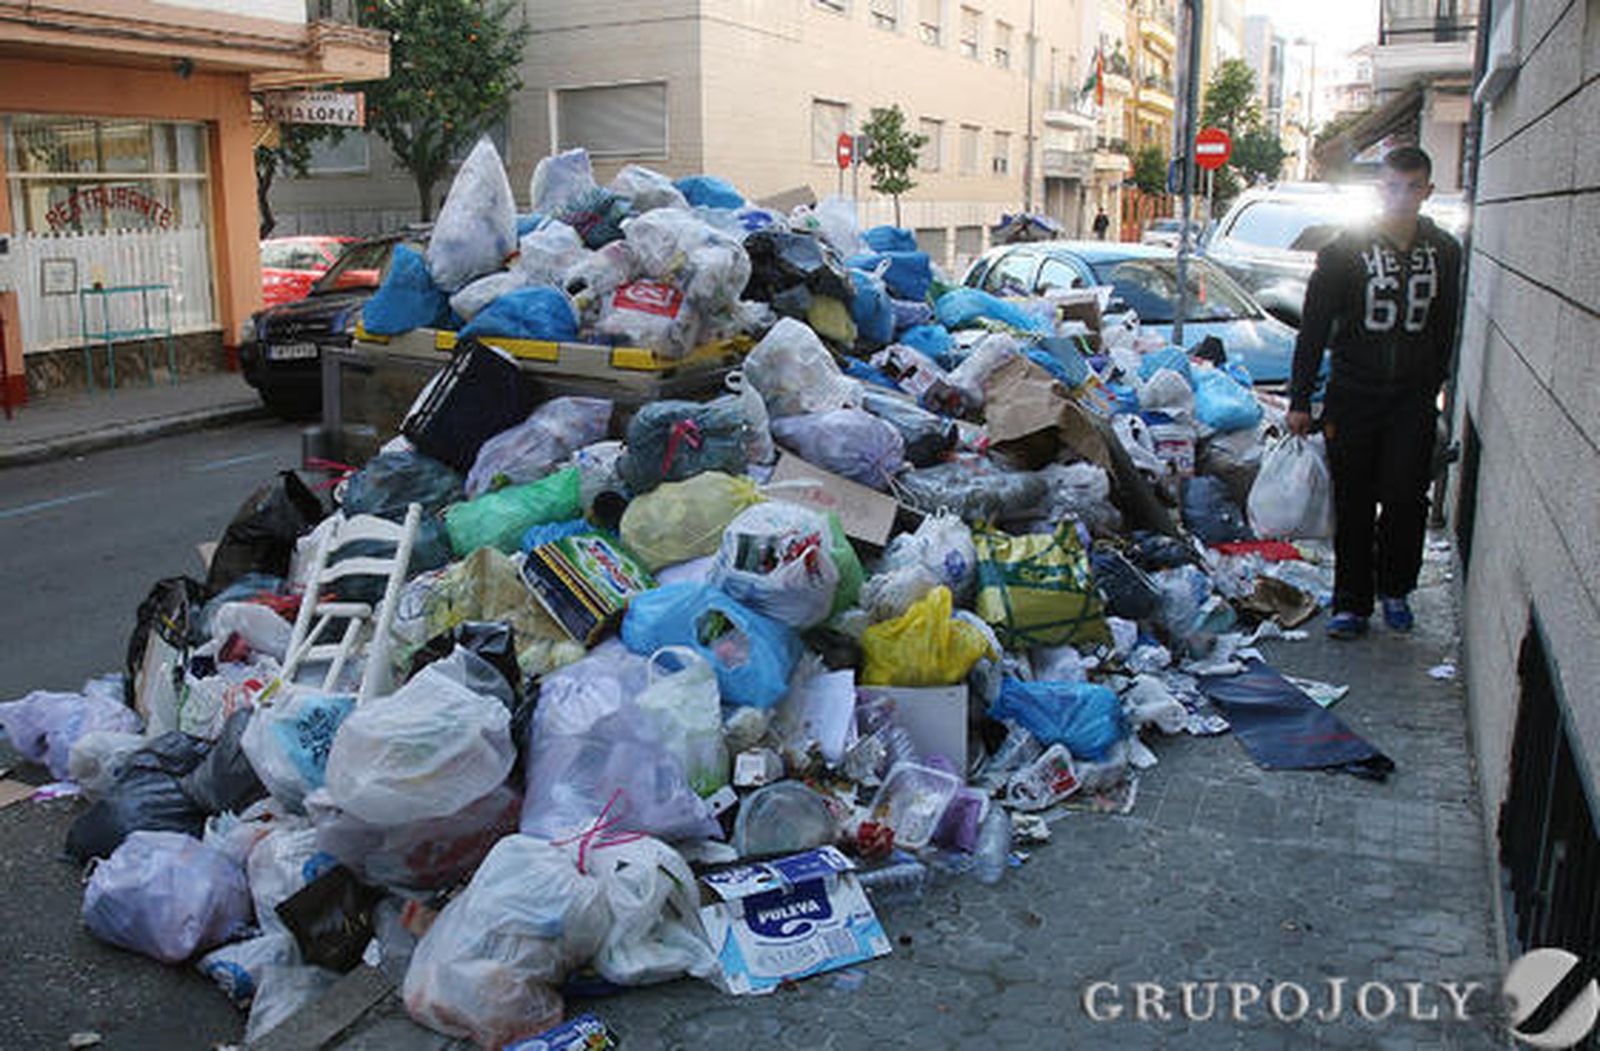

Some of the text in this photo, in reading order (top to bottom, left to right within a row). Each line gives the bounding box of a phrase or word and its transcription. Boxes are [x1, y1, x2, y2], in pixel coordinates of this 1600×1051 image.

[45, 187, 173, 231] RESTAURANTE
[1365, 274, 1437, 332] 68
[757, 899, 822, 925] PULEVA
